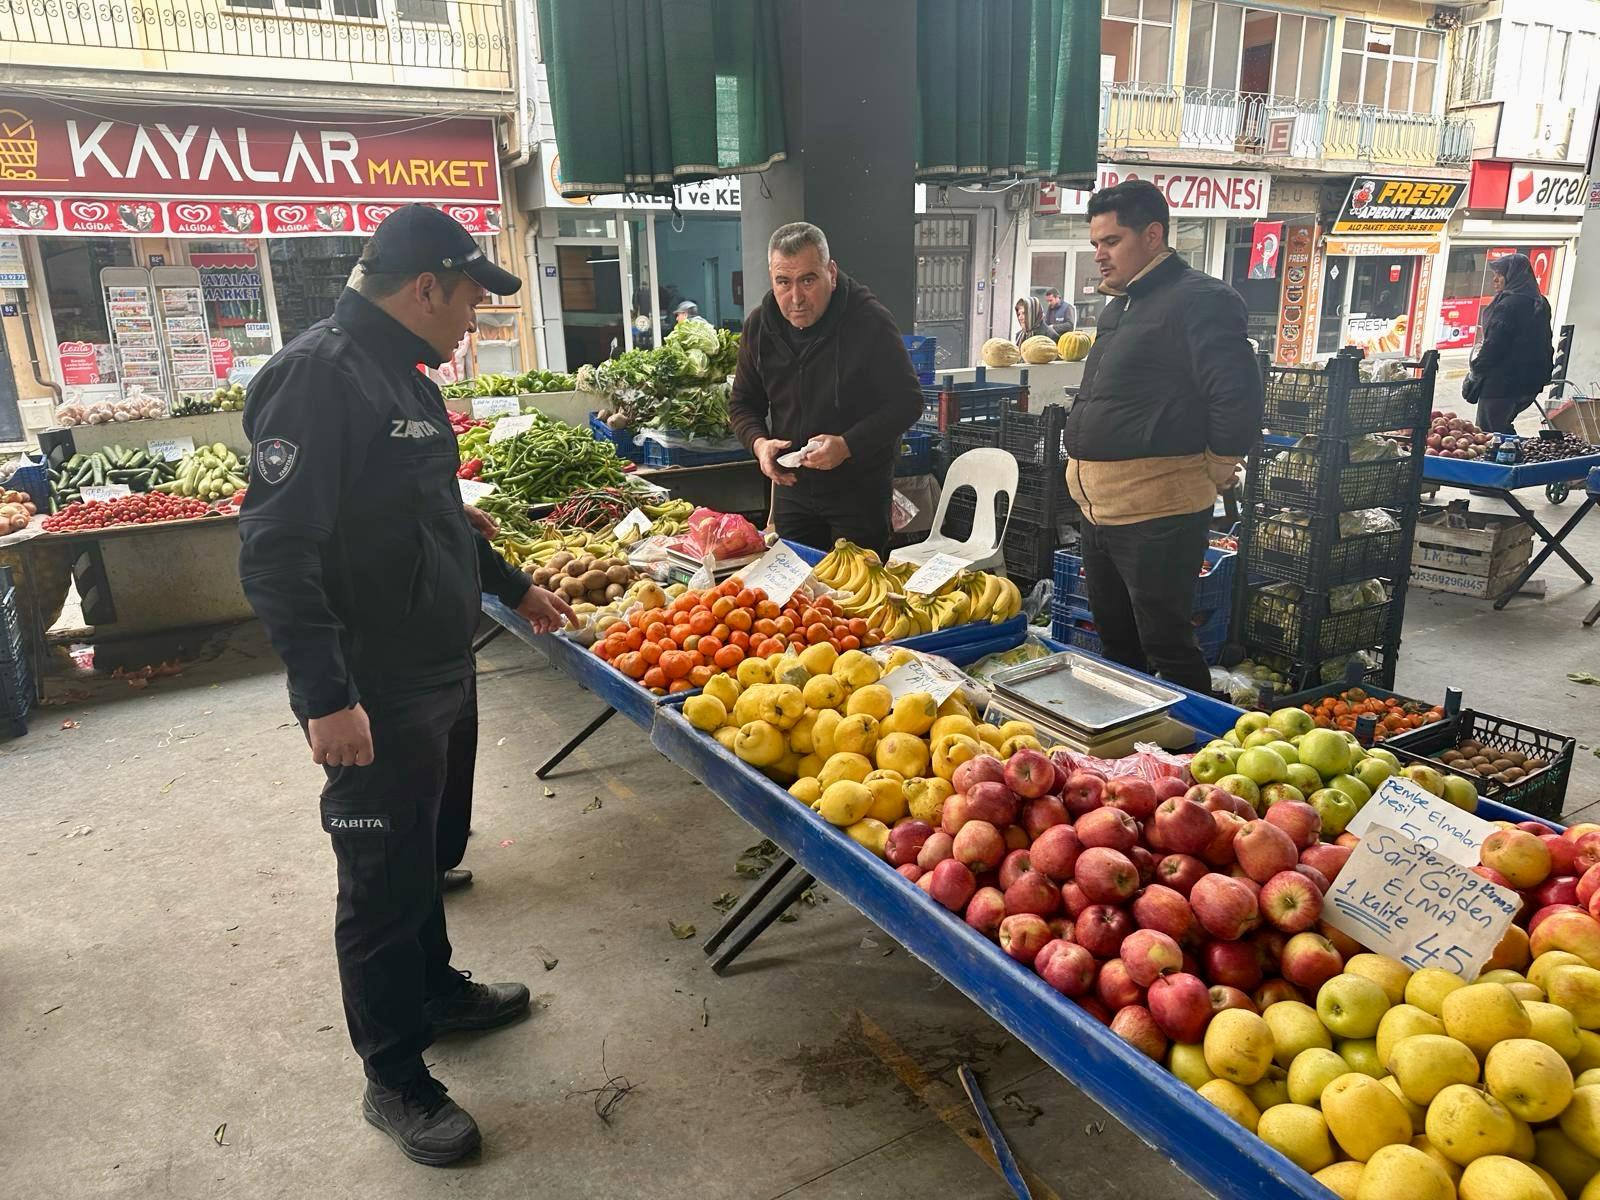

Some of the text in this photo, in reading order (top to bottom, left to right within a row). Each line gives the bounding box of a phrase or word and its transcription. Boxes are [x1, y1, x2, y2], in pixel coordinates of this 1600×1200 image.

[1272, 125, 1289, 149] E
[66, 120, 488, 187] KAYALAR MARKET
[689, 192, 710, 204] ve
[1377, 181, 1456, 206] FRESH
[1346, 243, 1382, 254] FRESH
[1350, 319, 1389, 331] FRESH
[330, 818, 384, 828] ZABITA
[1383, 878, 1457, 927] ELMA
[1419, 871, 1493, 928] Golden
[1415, 932, 1473, 976] 45
